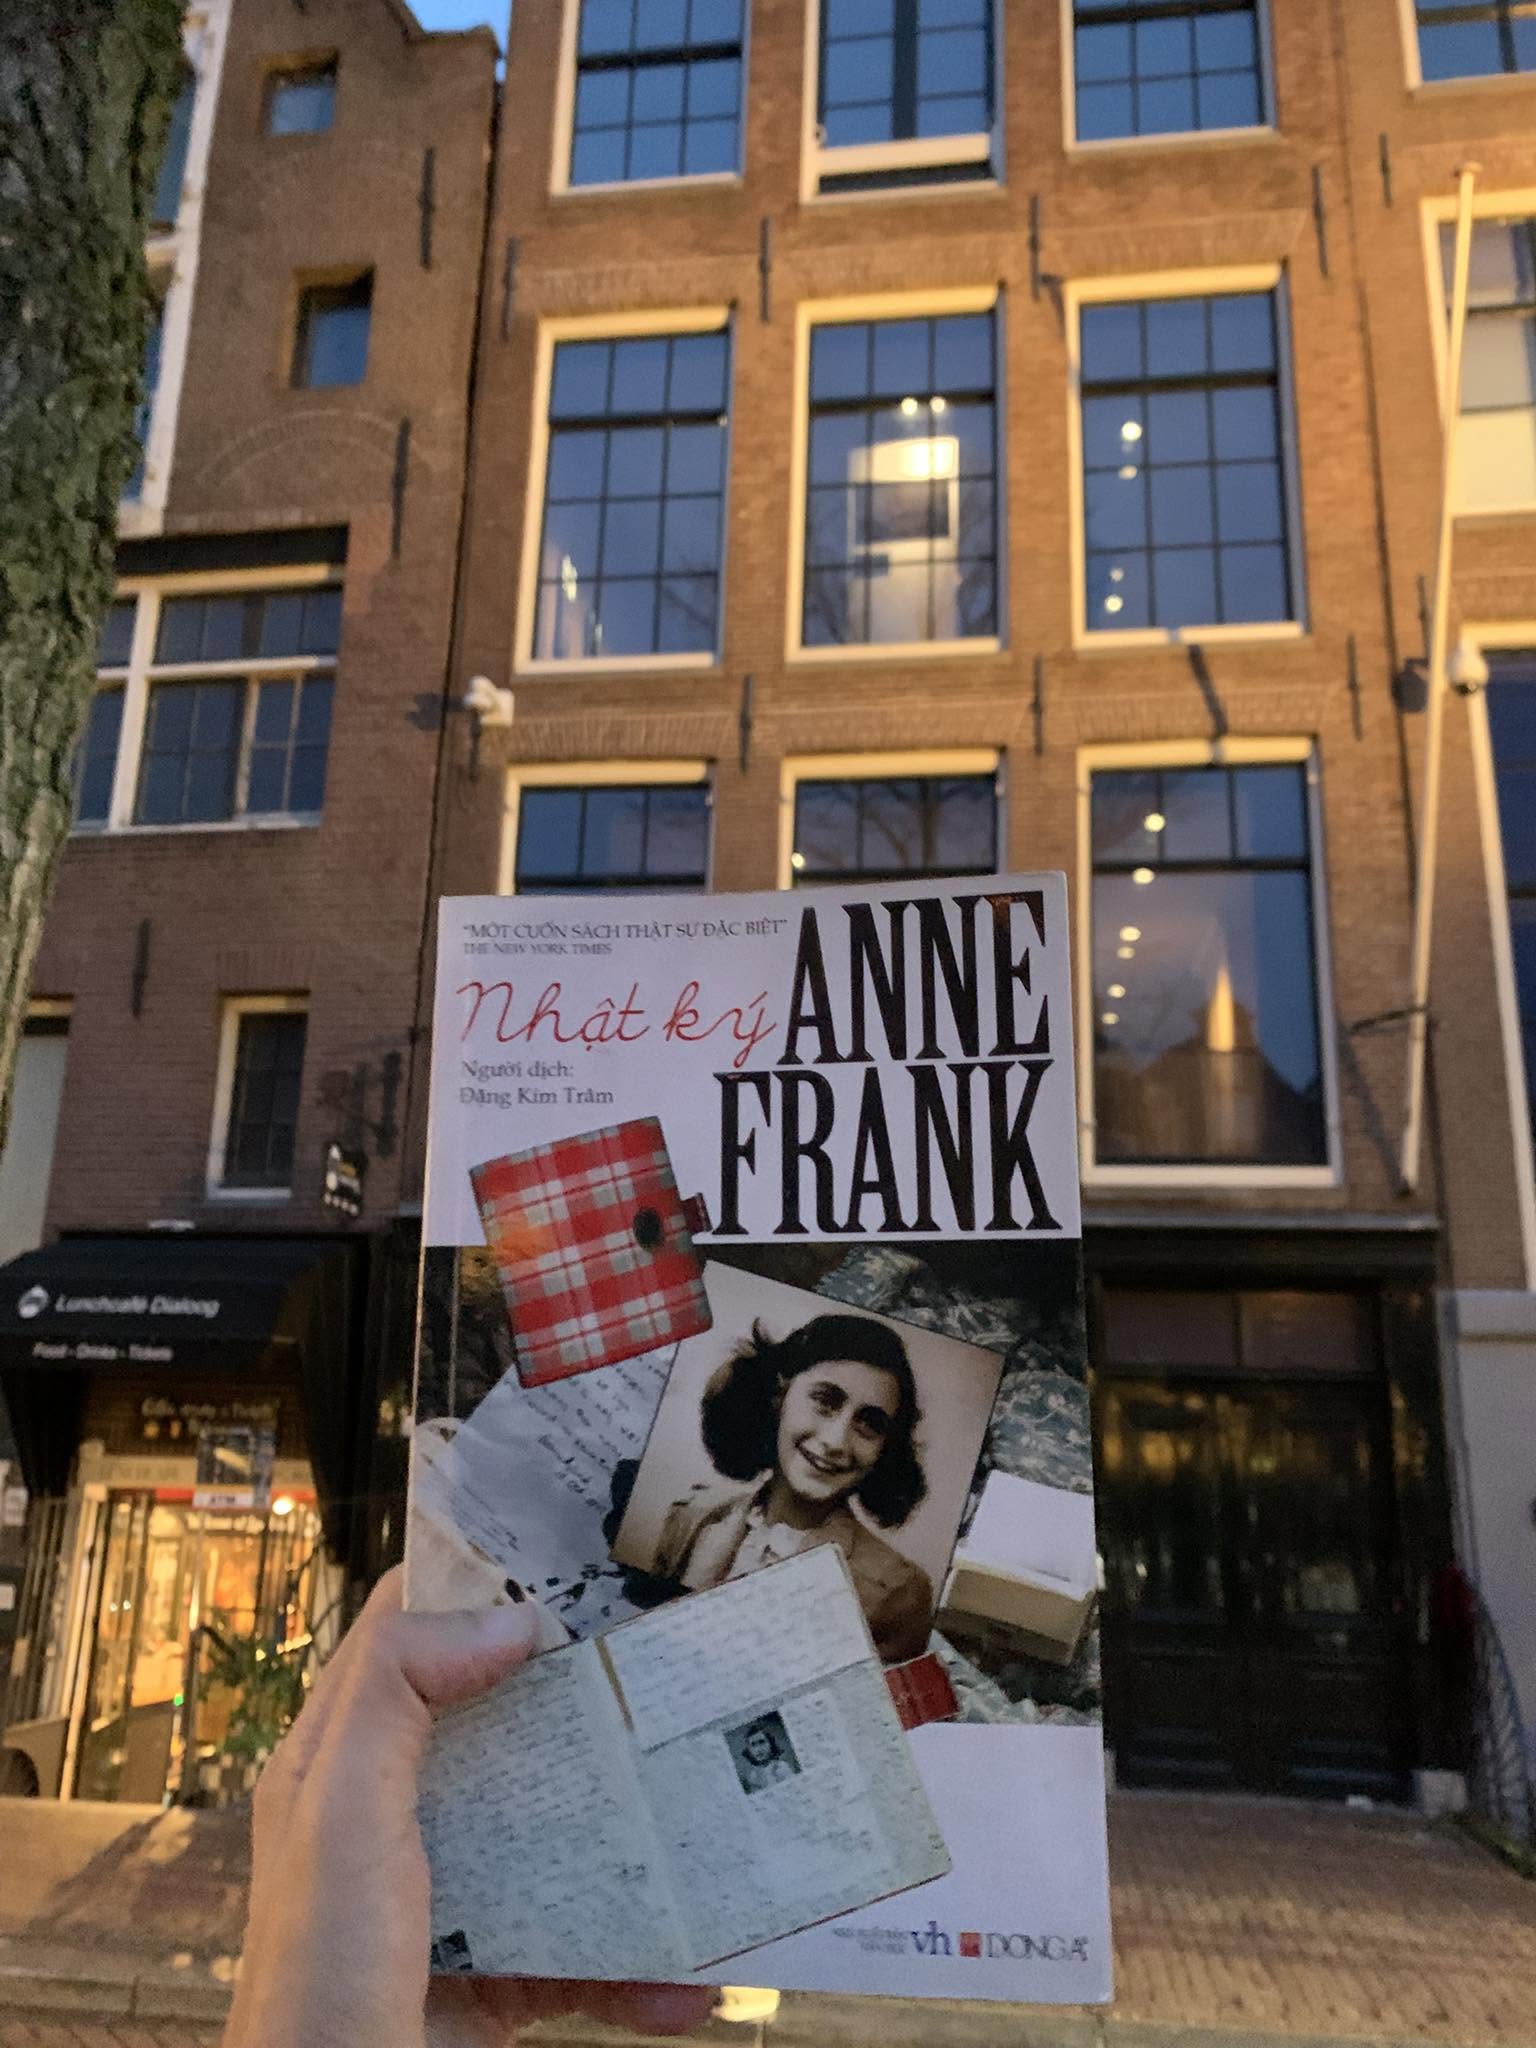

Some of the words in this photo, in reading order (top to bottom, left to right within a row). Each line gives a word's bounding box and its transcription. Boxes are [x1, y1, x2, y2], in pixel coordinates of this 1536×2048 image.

[572, 922, 621, 939] SÁCH
[464, 942, 491, 955] THE
[494, 942, 526, 955] NEW
[529, 942, 568, 955] YORK
[572, 942, 614, 955] TIMES
[777, 890, 1050, 1065] ANNE
[456, 981, 650, 1052] Nhật
[663, 980, 777, 1068] ký
[462, 1060, 522, 1082] Người
[527, 1060, 574, 1080] dịch:
[517, 1087, 558, 1105] Kim
[711, 1059, 1064, 1235] FRANK
